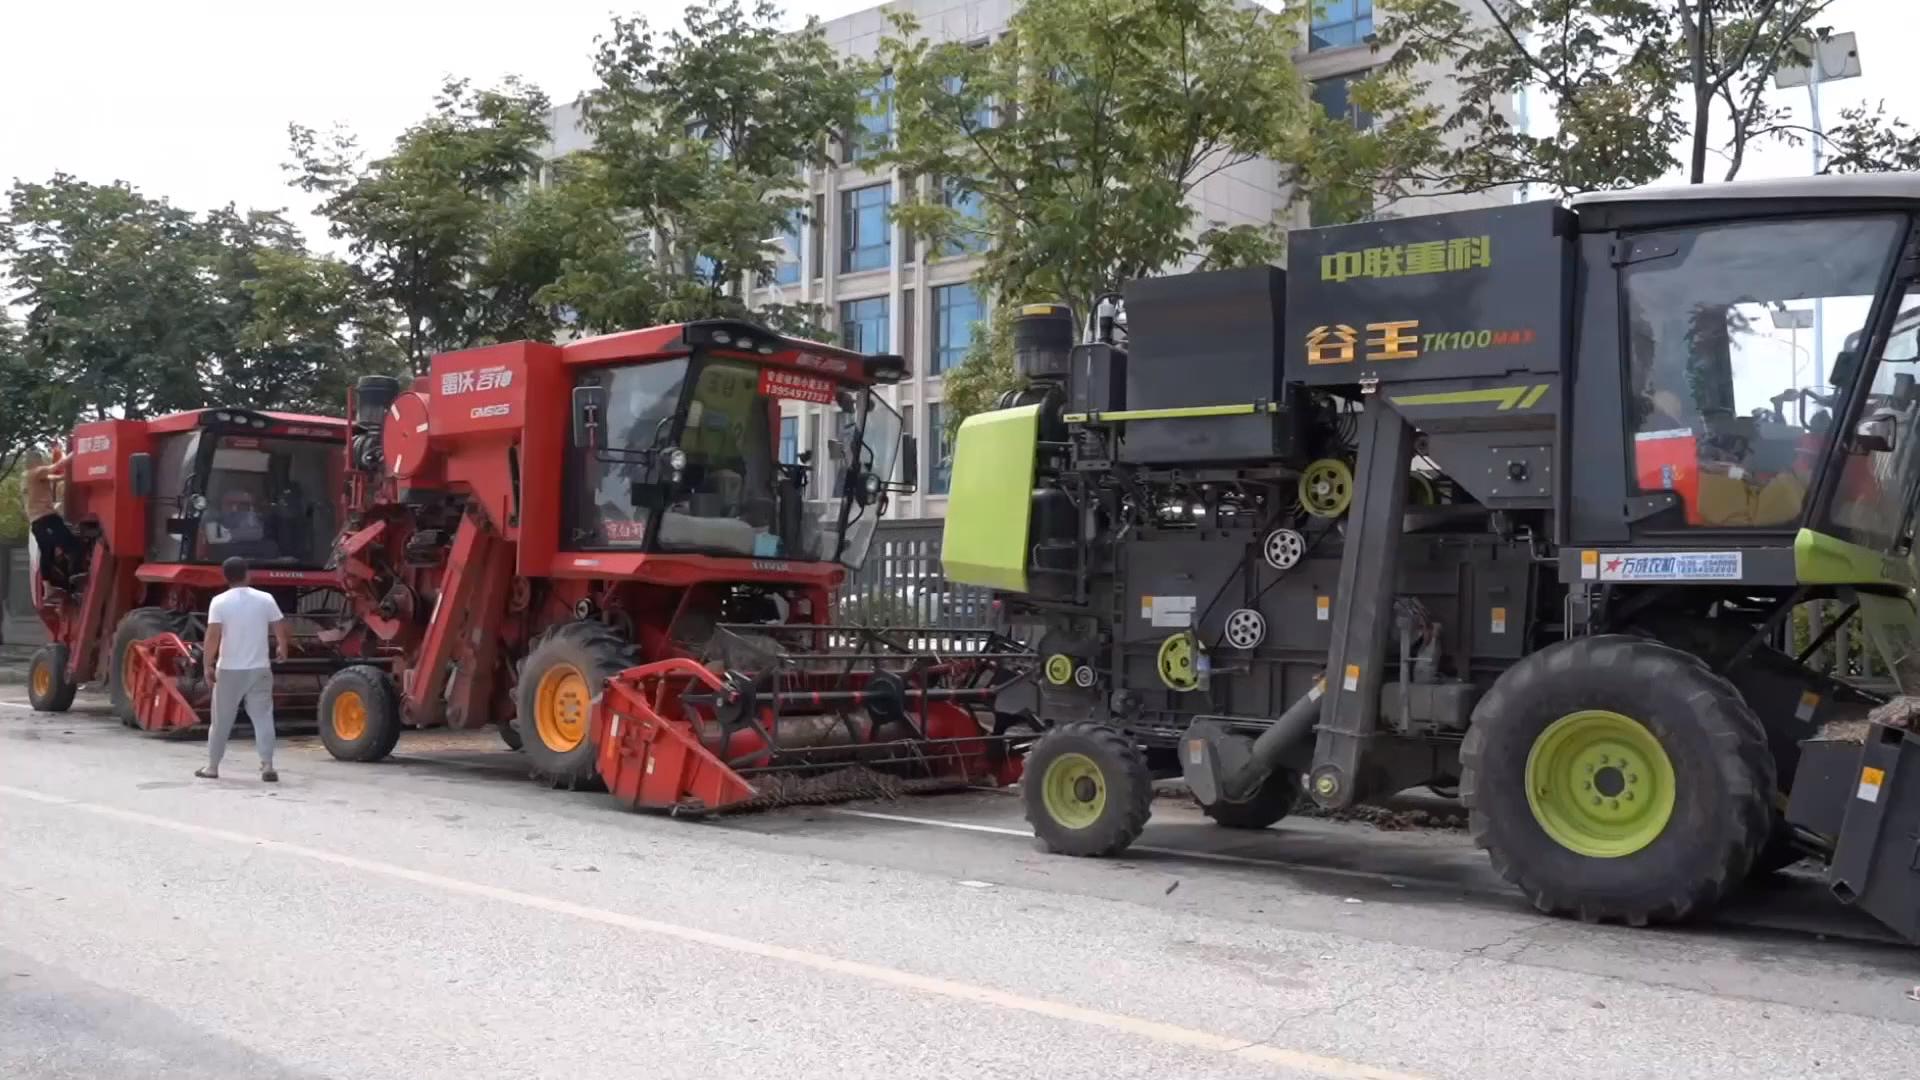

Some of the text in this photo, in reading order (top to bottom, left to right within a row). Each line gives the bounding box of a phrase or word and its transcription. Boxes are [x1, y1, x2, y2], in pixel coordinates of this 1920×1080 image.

[1321, 236, 1491, 282] 中联重科
[1306, 320, 1419, 365] 谷王
